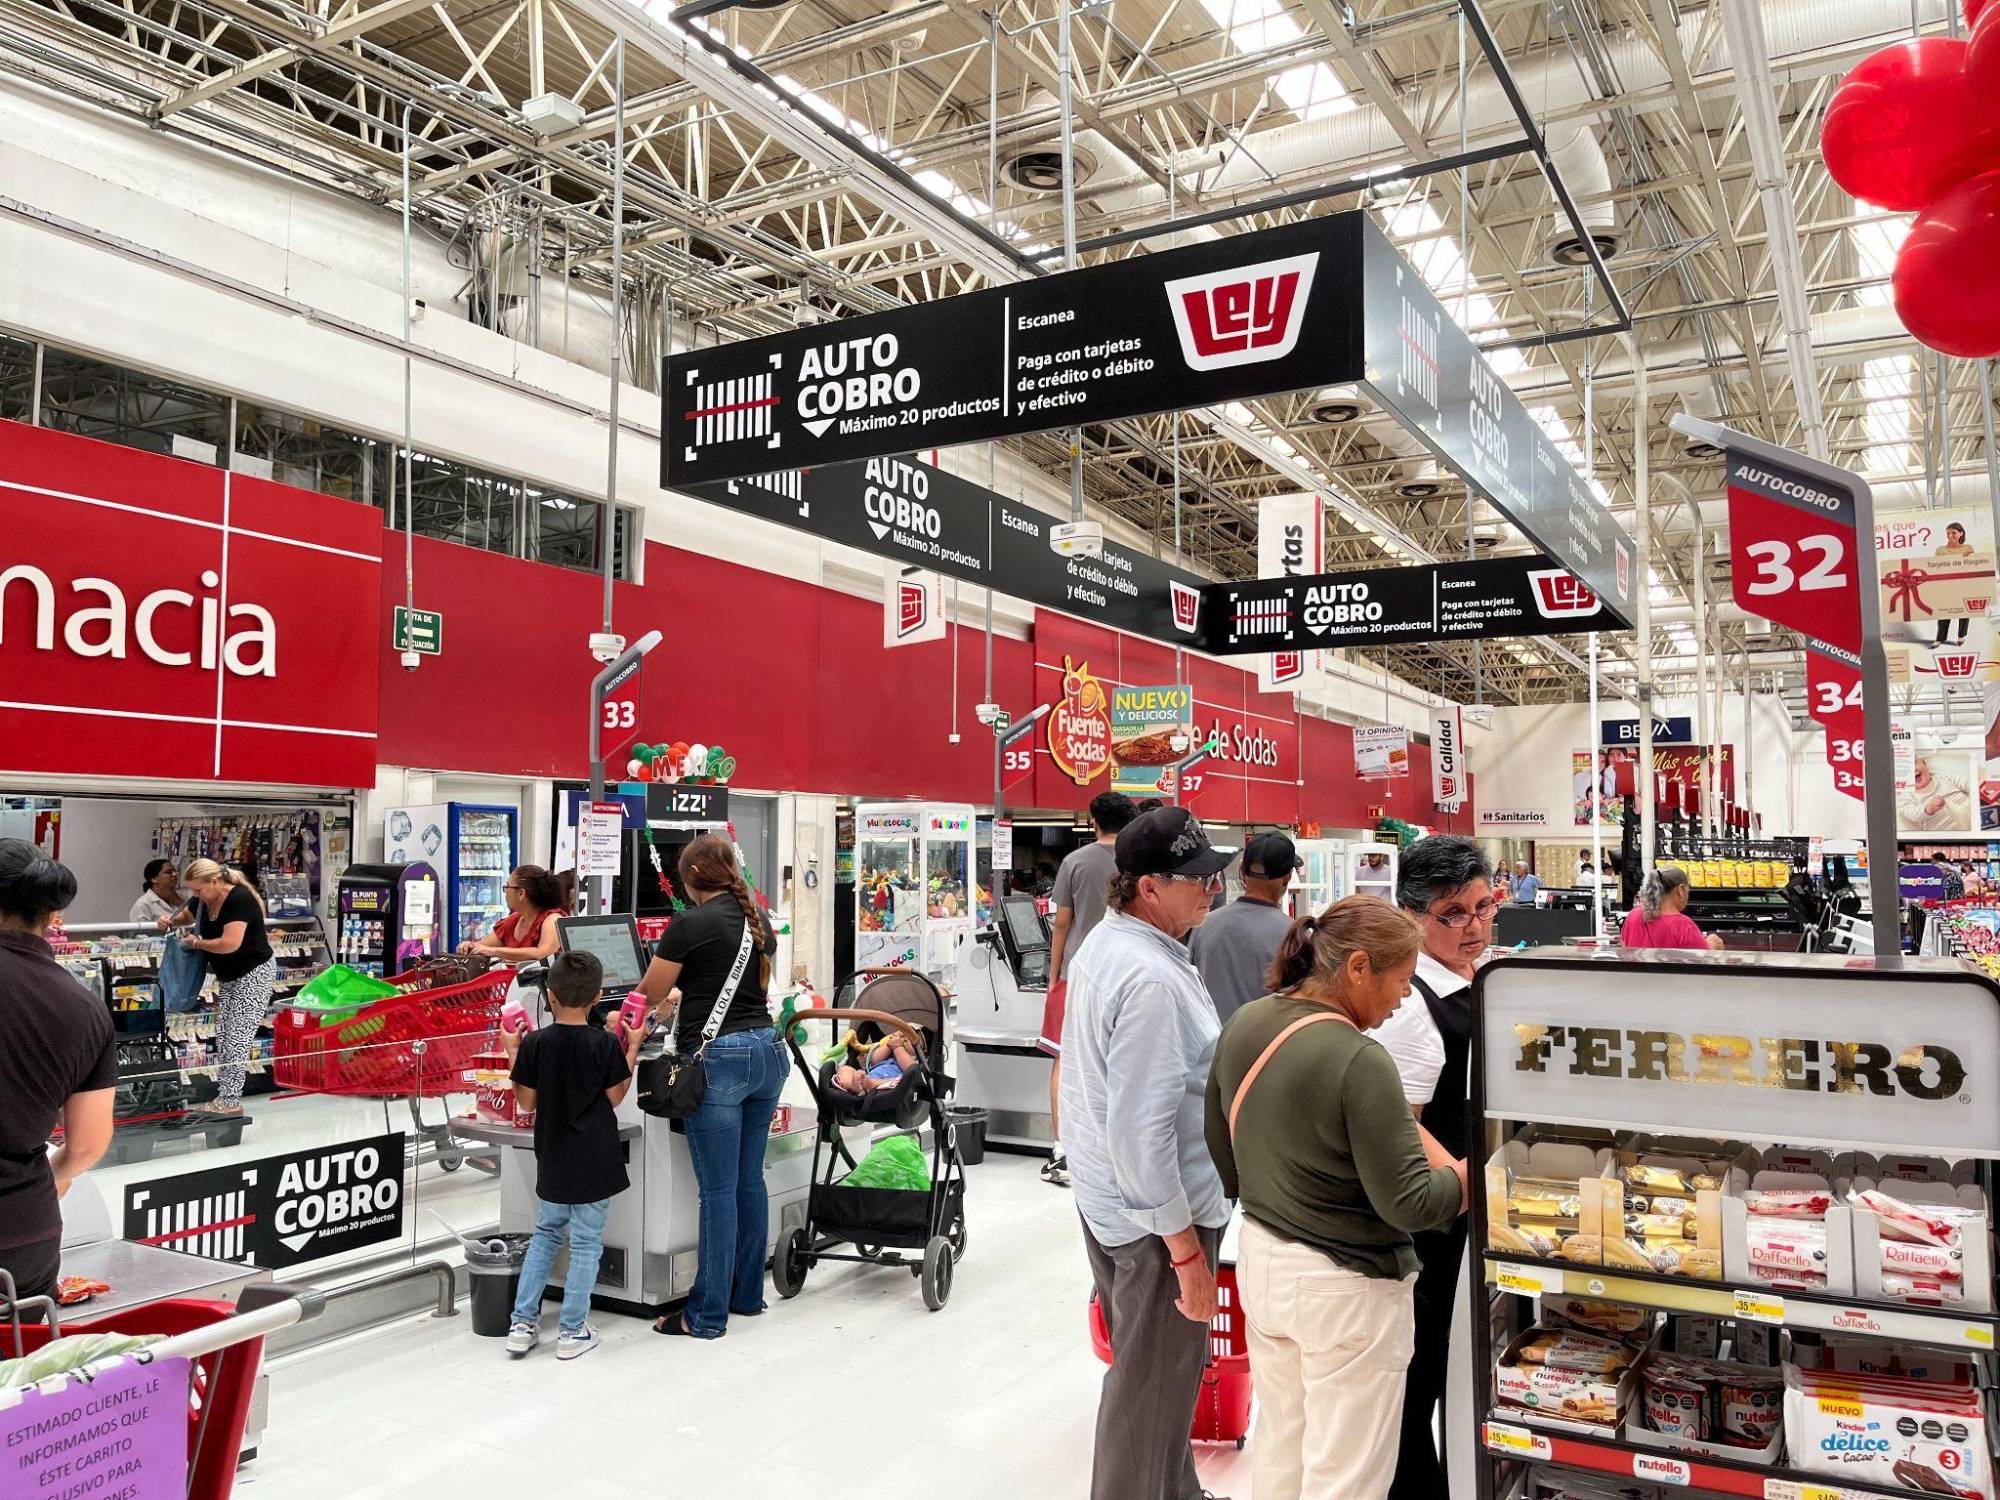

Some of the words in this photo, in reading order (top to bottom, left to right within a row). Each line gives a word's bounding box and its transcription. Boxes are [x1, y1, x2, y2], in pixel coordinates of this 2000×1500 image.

[1018, 309, 1075, 331] Escanea
[798, 333, 898, 382] AUTO
[1018, 354, 1051, 371] Paga
[1055, 347, 1081, 363] con
[1084, 336, 1142, 359] tarjetas
[1017, 375, 1035, 391] de
[1038, 366, 1089, 389] crédito
[1091, 367, 1102, 380] o
[1104, 356, 1154, 377] débito
[797, 367, 921, 418] COBRO
[1469, 355, 1501, 421] AUTO
[1017, 401, 1026, 416] y
[1028, 389, 1087, 412] efectivo
[839, 413, 898, 434] Máximo
[900, 408, 919, 425] 20
[922, 397, 1000, 425] productos
[1469, 401, 1508, 469] COBRO
[865, 457, 928, 500] AUTO
[1734, 464, 1842, 513] AUTOCOBRO
[864, 486, 940, 538] COBRO
[1002, 509, 1039, 537] Escanea
[1875, 527, 1932, 551] alar?
[1893, 521, 1916, 533] que
[893, 529, 928, 553] Máximo
[929, 541, 940, 556] 20
[941, 548, 981, 569] productos
[1281, 525, 1303, 577] rtas
[1104, 550, 1132, 573] tarjetas
[1746, 534, 1848, 597] 32
[1926, 560, 1951, 569] Tarjeta
[1963, 558, 1989, 567] Regalo
[1067, 559, 1077, 576] de
[1079, 566, 1107, 586] crédito
[1108, 577, 1113, 588] o
[1114, 576, 1138, 597] débito
[1441, 579, 1476, 589] Escanea
[1067, 584, 1073, 599] y
[1074, 584, 1106, 607] efectivo
[1304, 583, 1369, 605] AUTO
[1441, 601, 1463, 611] Paga
[1464, 599, 1480, 608] con
[1481, 597, 1515, 607] tarjetas
[423, 614, 433, 624] DE
[1303, 602, 1383, 625] COBRO
[1441, 611, 1453, 621] de
[1455, 609, 1484, 620] crédito
[1493, 607, 1522, 617] débito
[1331, 623, 1368, 635] Máximo
[1370, 624, 1382, 633] 20
[1384, 619, 1432, 633] productos
[1441, 624, 1447, 633] y
[1449, 621, 1484, 631] efectivo
[604, 661, 638, 693] AUTOCOBRO
[1115, 690, 1187, 711] NUEVO
[1815, 680, 1864, 713] 34
[603, 701, 635, 729] 33
[1058, 709, 1105, 738] Fuente
[1118, 712, 1126, 720] Y
[1208, 718, 1229, 760] de
[1233, 724, 1278, 766] Sodas
[1355, 728, 1366, 737] TU
[1892, 731, 1911, 741] ena
[1066, 735, 1105, 762] Sodas
[1438, 719, 1453, 773] Calidad
[1004, 751, 1031, 770] 35
[1112, 769, 1118, 778] $
[1182, 776, 1203, 791] 37
[1494, 811, 1545, 822] Sanitarios
[710, 1016, 719, 1028] Y
[715, 988, 733, 1015] LOLA
[731, 946, 749, 981] BIMBA
[744, 936, 751, 945] Y
[1513, 1023, 1968, 1100] FERRERO
[276, 1147, 379, 1198] AUTO
[274, 1178, 398, 1234] COBRO
[319, 1225, 348, 1238] Máximo
[349, 1222, 359, 1230] 20
[360, 1213, 395, 1229] productos
[1752, 1247, 1812, 1268] Raffaello
[1886, 1246, 1948, 1267] Raffaello
[1833, 1315, 1881, 1331] Raffaello
[1566, 1337, 1604, 1348] nutella
[1499, 1379, 1531, 1390] nutella
[1536, 1372, 1576, 1384] nutella
[7, 1408, 82, 1448] ESTIMADO
[86, 1386, 142, 1416] CLIENTE,
[146, 1378, 160, 1394] LE
[1736, 1409, 1780, 1424] nutella
[1821, 1403, 1861, 1417] NUEVO
[18, 1418, 118, 1470] INFORMAMOS
[121, 1406, 150, 1427] QUE
[39, 1462, 72, 1488] ÉSTE
[75, 1437, 132, 1471] CARRITO
[107, 1458, 143, 1482] PARA
[1638, 1460, 1682, 1474] nutella
[1945, 1453, 1957, 1467] 3
